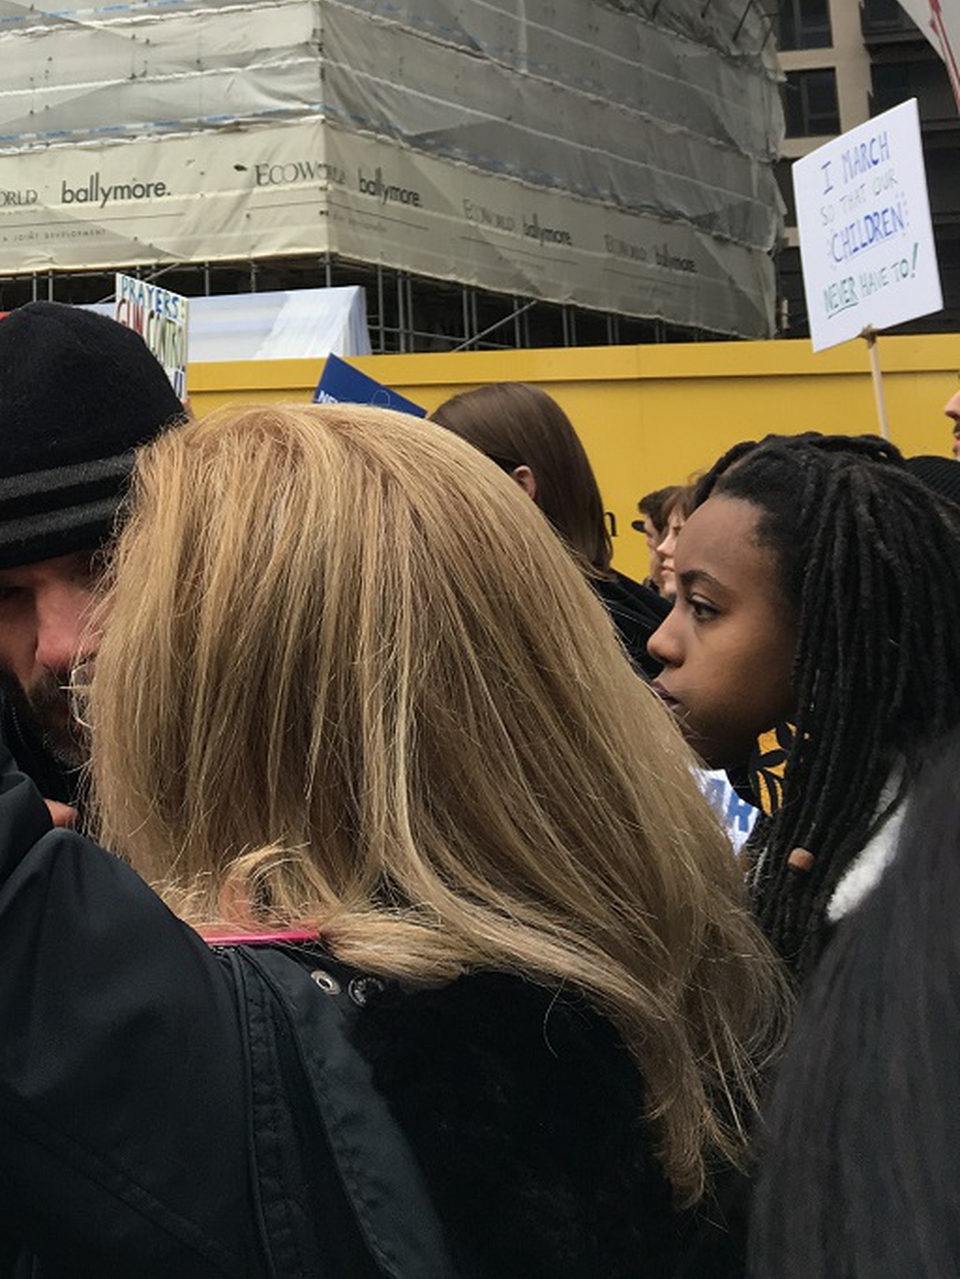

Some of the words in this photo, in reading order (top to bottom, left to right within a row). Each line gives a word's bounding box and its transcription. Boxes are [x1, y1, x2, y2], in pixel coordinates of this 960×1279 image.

[61, 172, 171, 209] ballymore.
[821, 161, 834, 195] I
[841, 131, 891, 184] MARCH
[830, 202, 906, 263] CHILDREN
[823, 276, 859, 312] NEVER
[860, 266, 890, 299] HAVE
[892, 242, 919, 282] TO!
